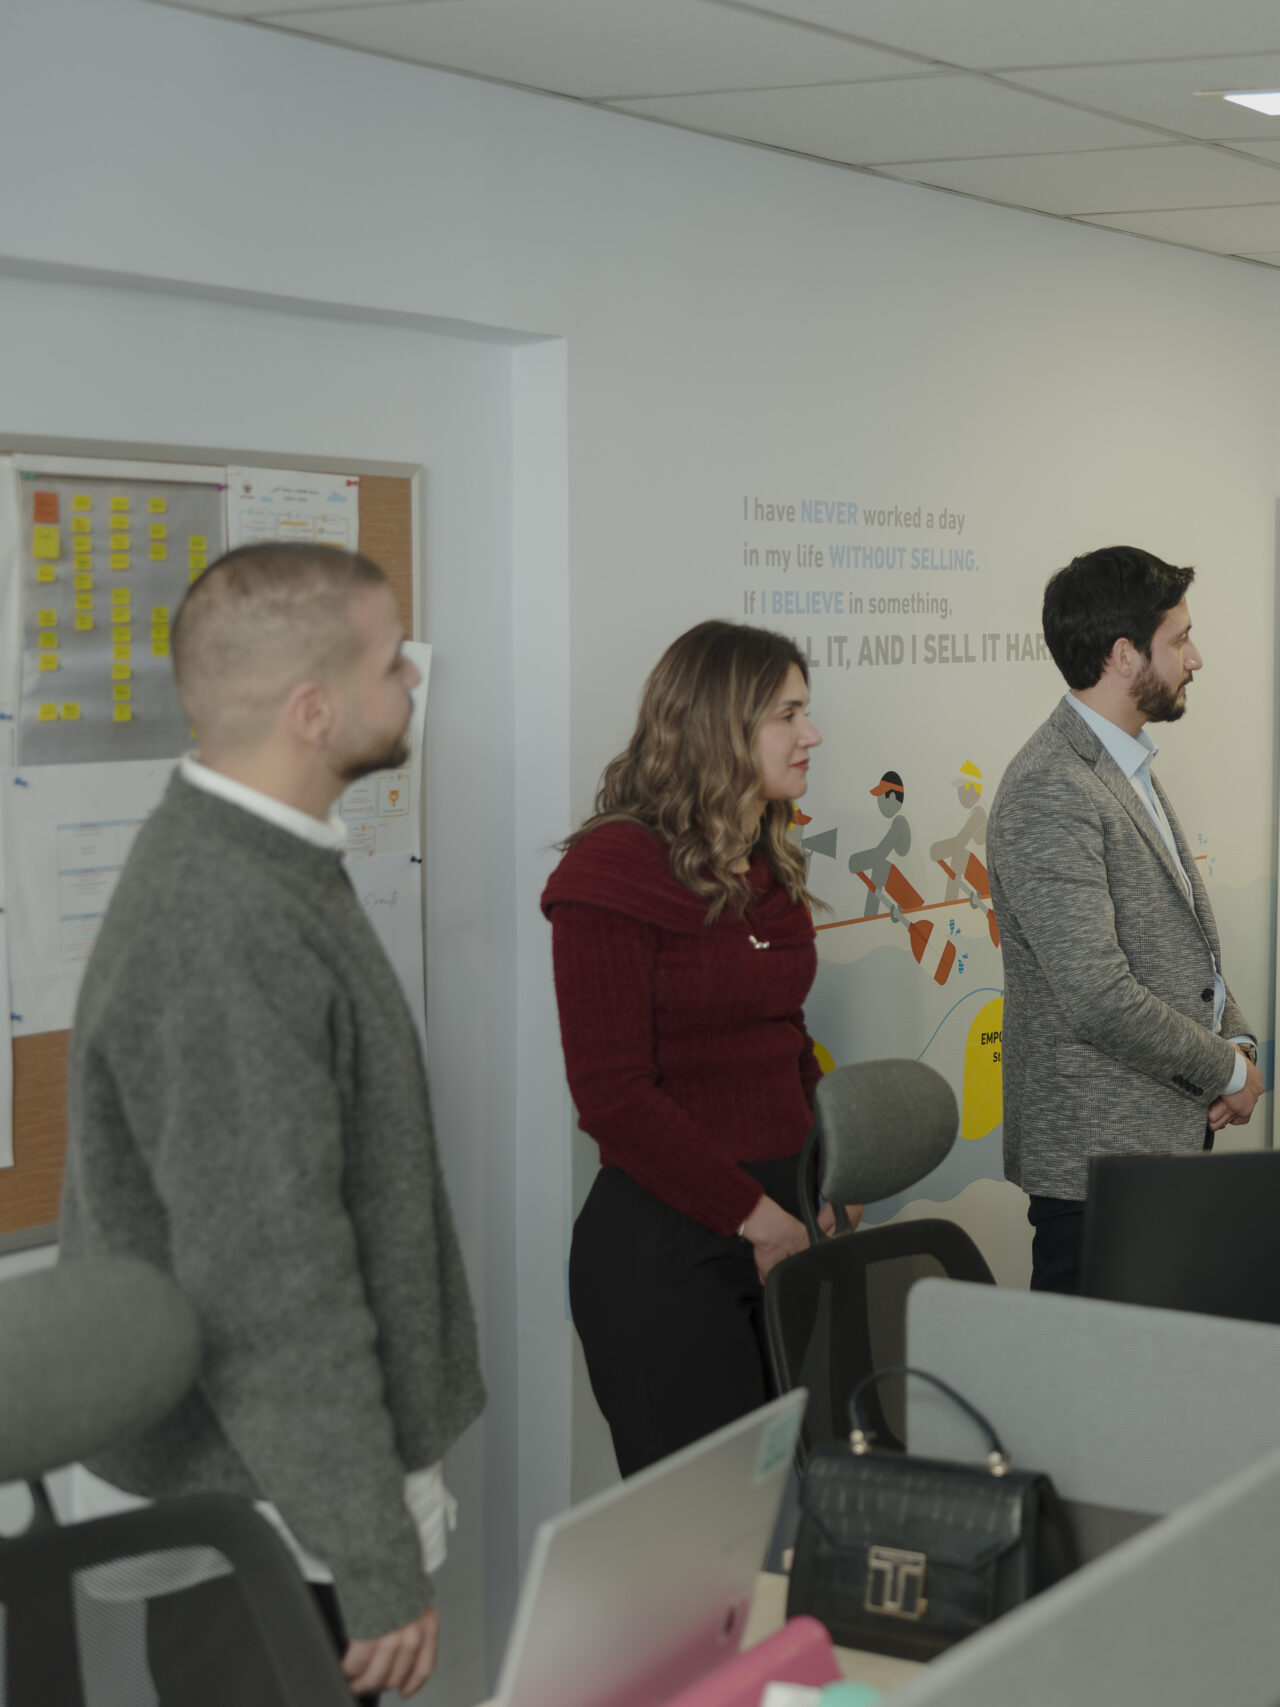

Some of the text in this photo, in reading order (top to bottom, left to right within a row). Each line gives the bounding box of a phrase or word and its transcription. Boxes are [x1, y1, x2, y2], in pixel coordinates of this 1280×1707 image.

[754, 497, 796, 522] have
[801, 499, 858, 526] NEVER
[863, 504, 922, 529] worked
[926, 511, 935, 529] a
[938, 507, 966, 535] day
[743, 542, 980, 573] in my life WITHOUT SELLING.
[743, 591, 756, 615] If
[772, 590, 844, 615] BELIEVE
[849, 591, 864, 614] in
[868, 591, 952, 619] something,
[827, 635, 852, 670] IT,
[858, 634, 905, 667] AND
[911, 633, 917, 664] I
[924, 633, 977, 664] SELL
[982, 632, 1001, 662] IT
[1006, 632, 1053, 662] HAR
